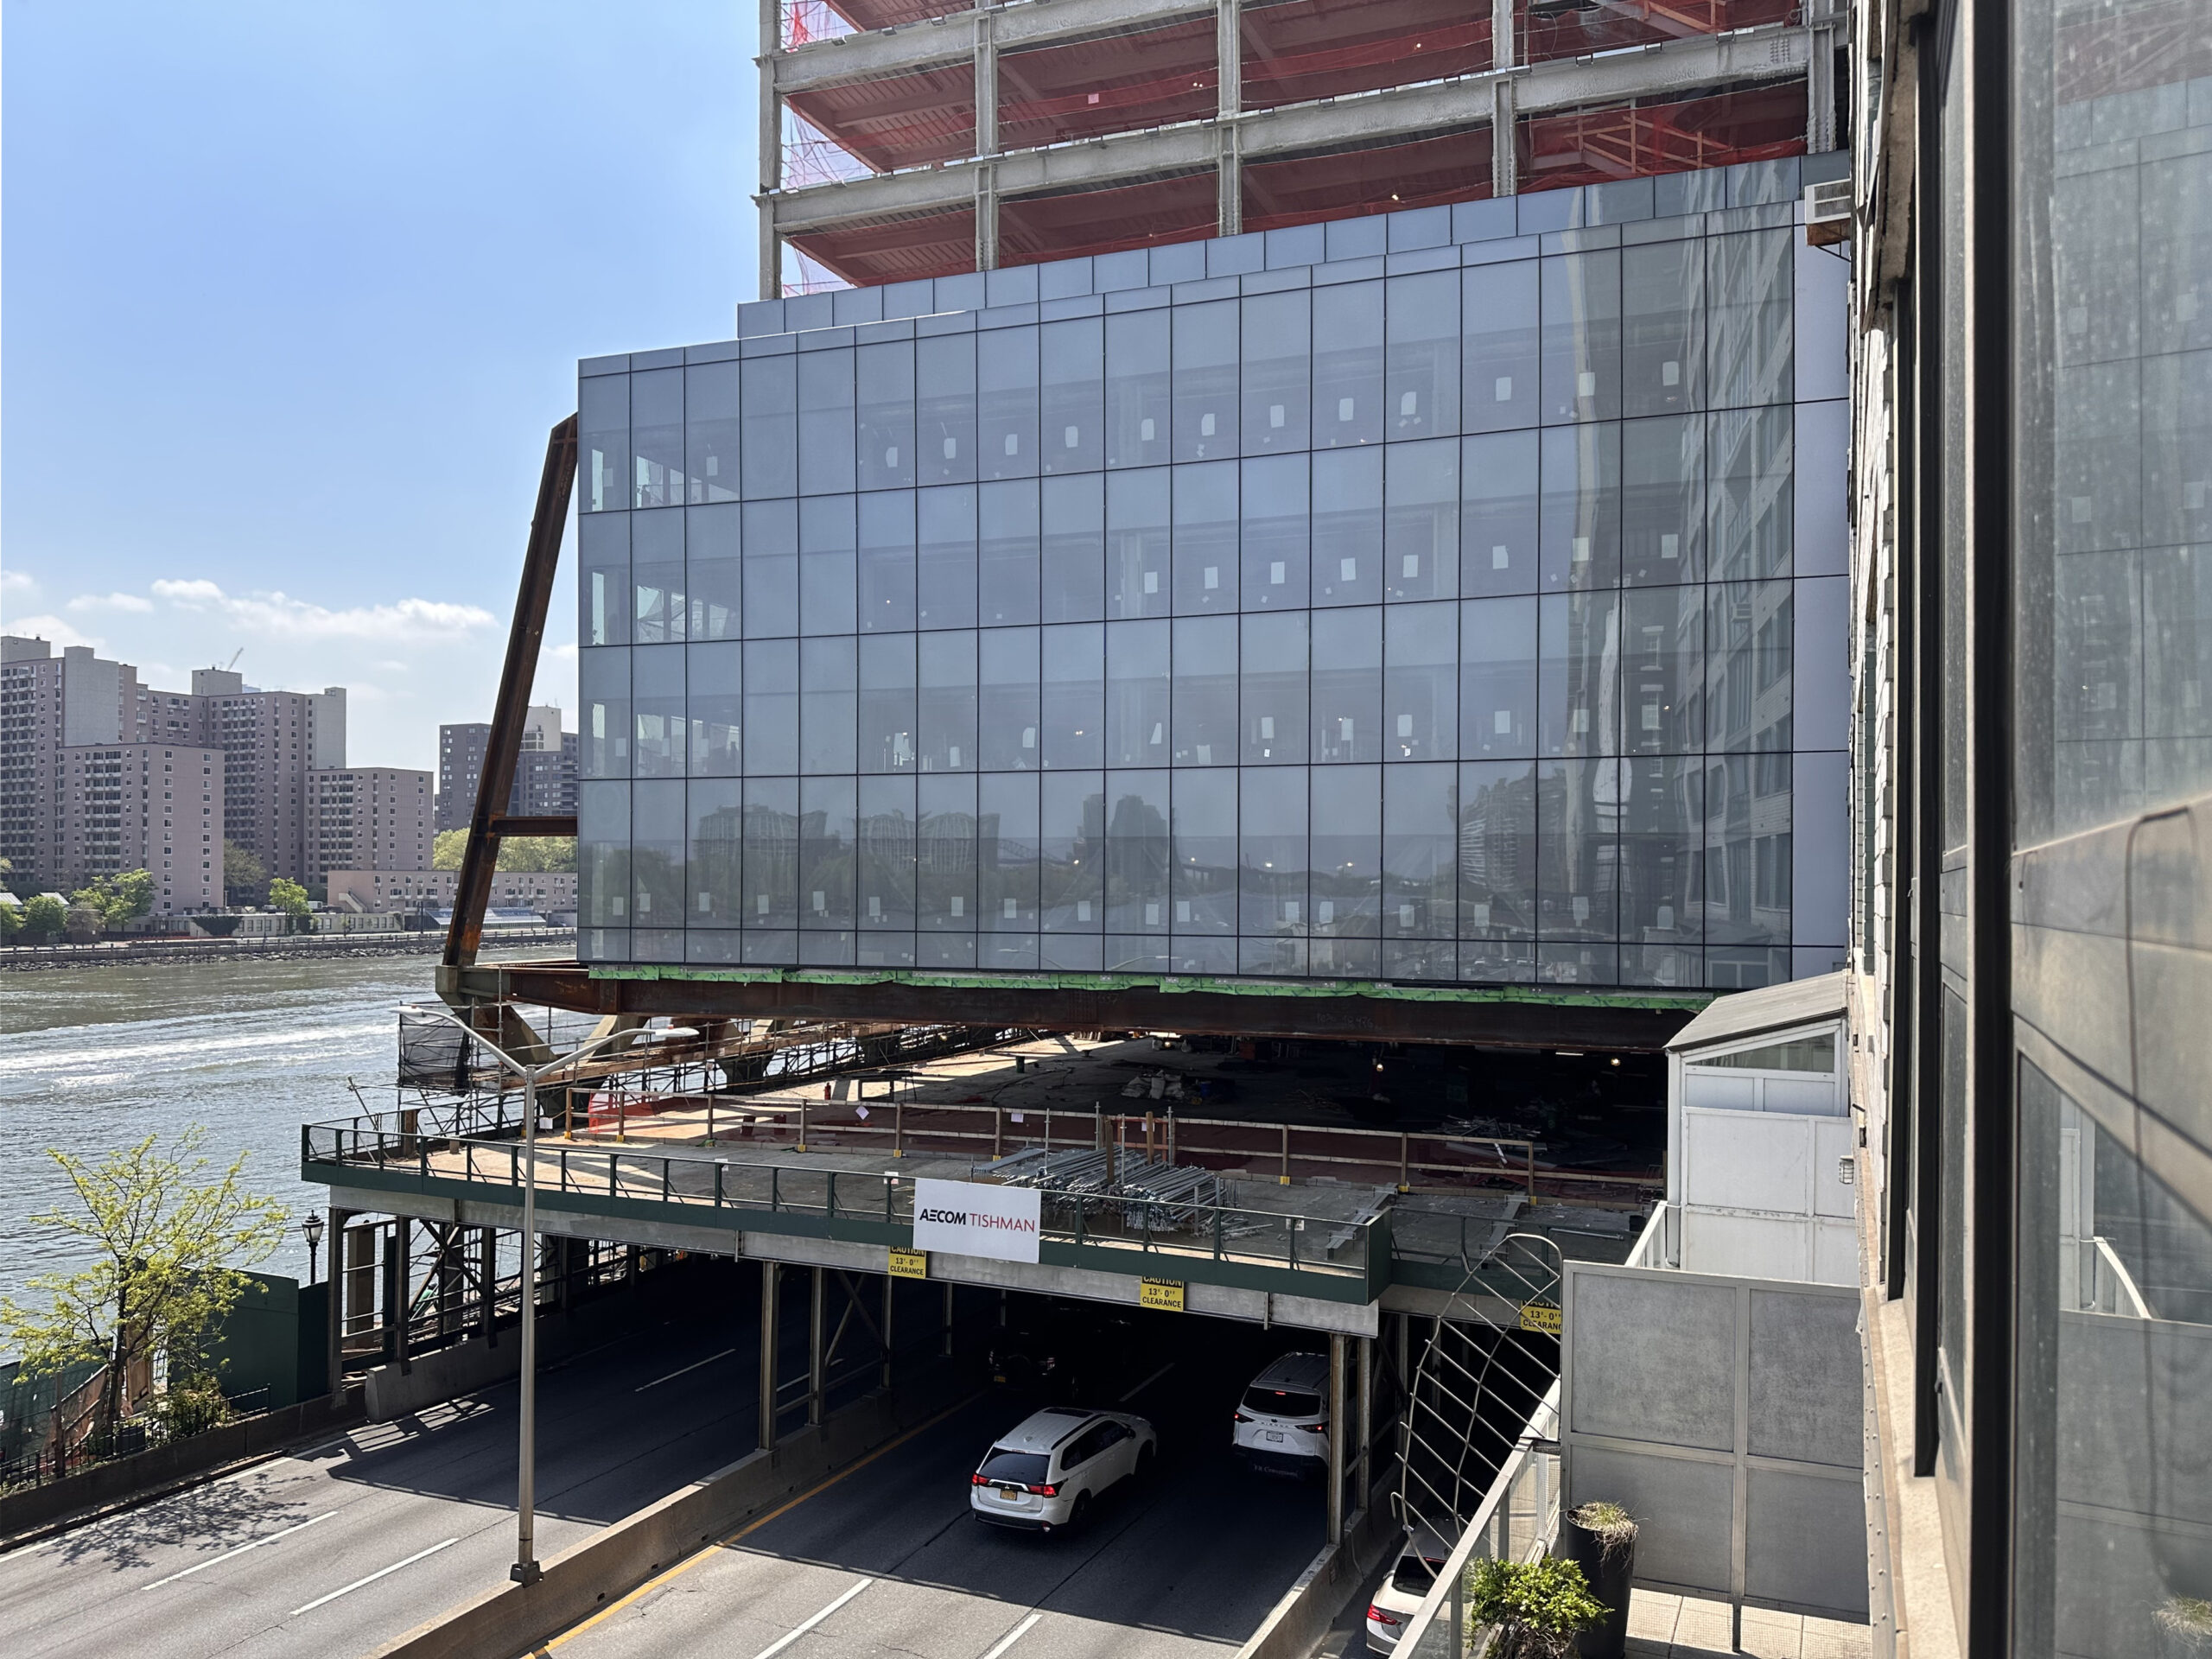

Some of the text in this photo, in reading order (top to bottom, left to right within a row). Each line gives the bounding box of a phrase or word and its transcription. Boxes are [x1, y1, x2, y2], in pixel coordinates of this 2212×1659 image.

[918, 1208, 1035, 1233] AECOM TISHMAN
[890, 1265, 924, 1275] CLEARANCE
[1142, 1296, 1181, 1307] CLEARANCE
